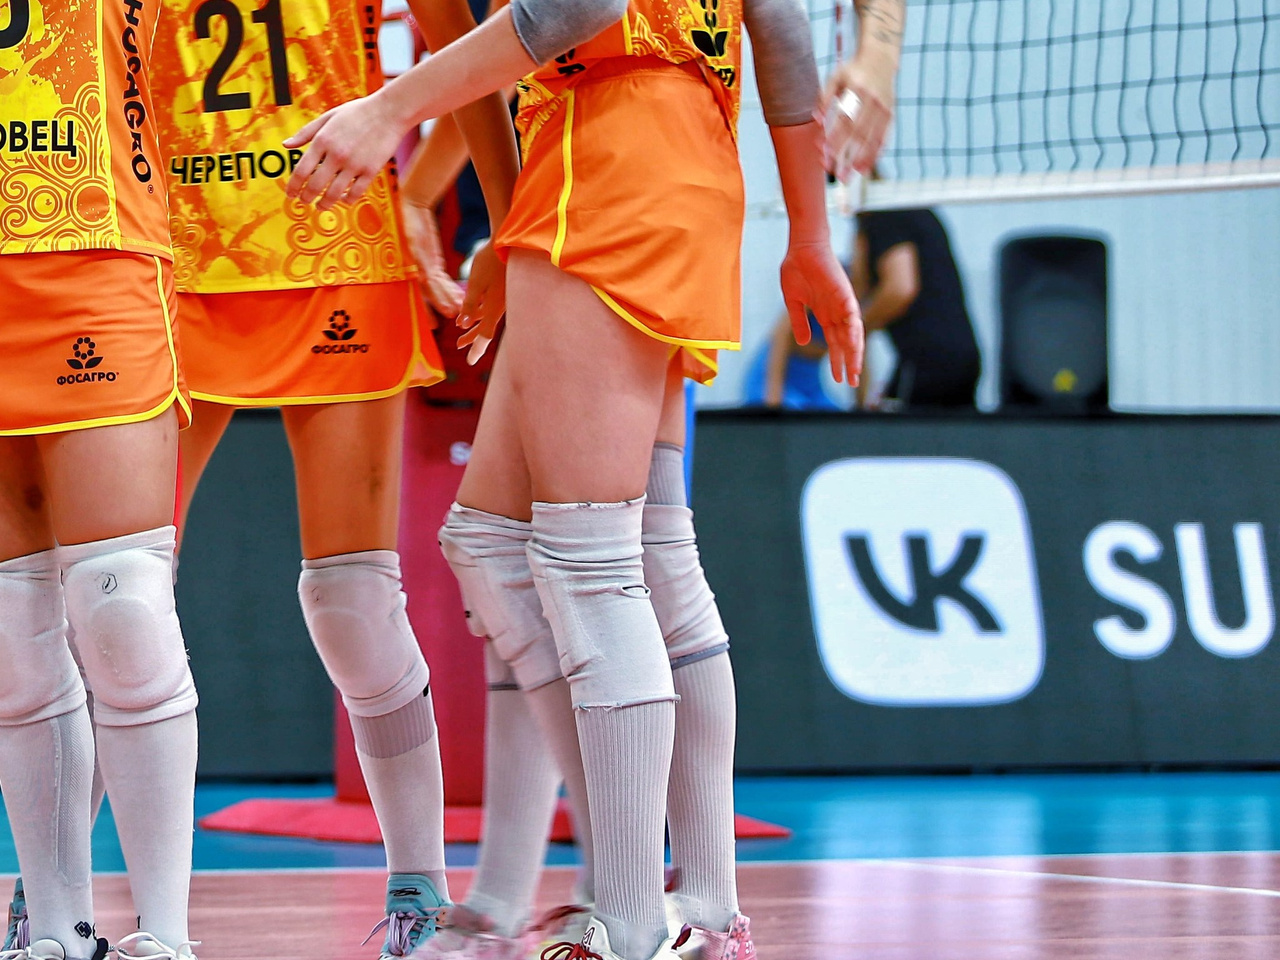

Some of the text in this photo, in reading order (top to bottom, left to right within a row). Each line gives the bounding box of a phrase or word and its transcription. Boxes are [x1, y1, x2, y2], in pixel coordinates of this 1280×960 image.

[311, 343, 369, 355] ФОСАГРО
[56, 371, 118, 386] ФОСАГРО
[842, 519, 1276, 660] VK SU
